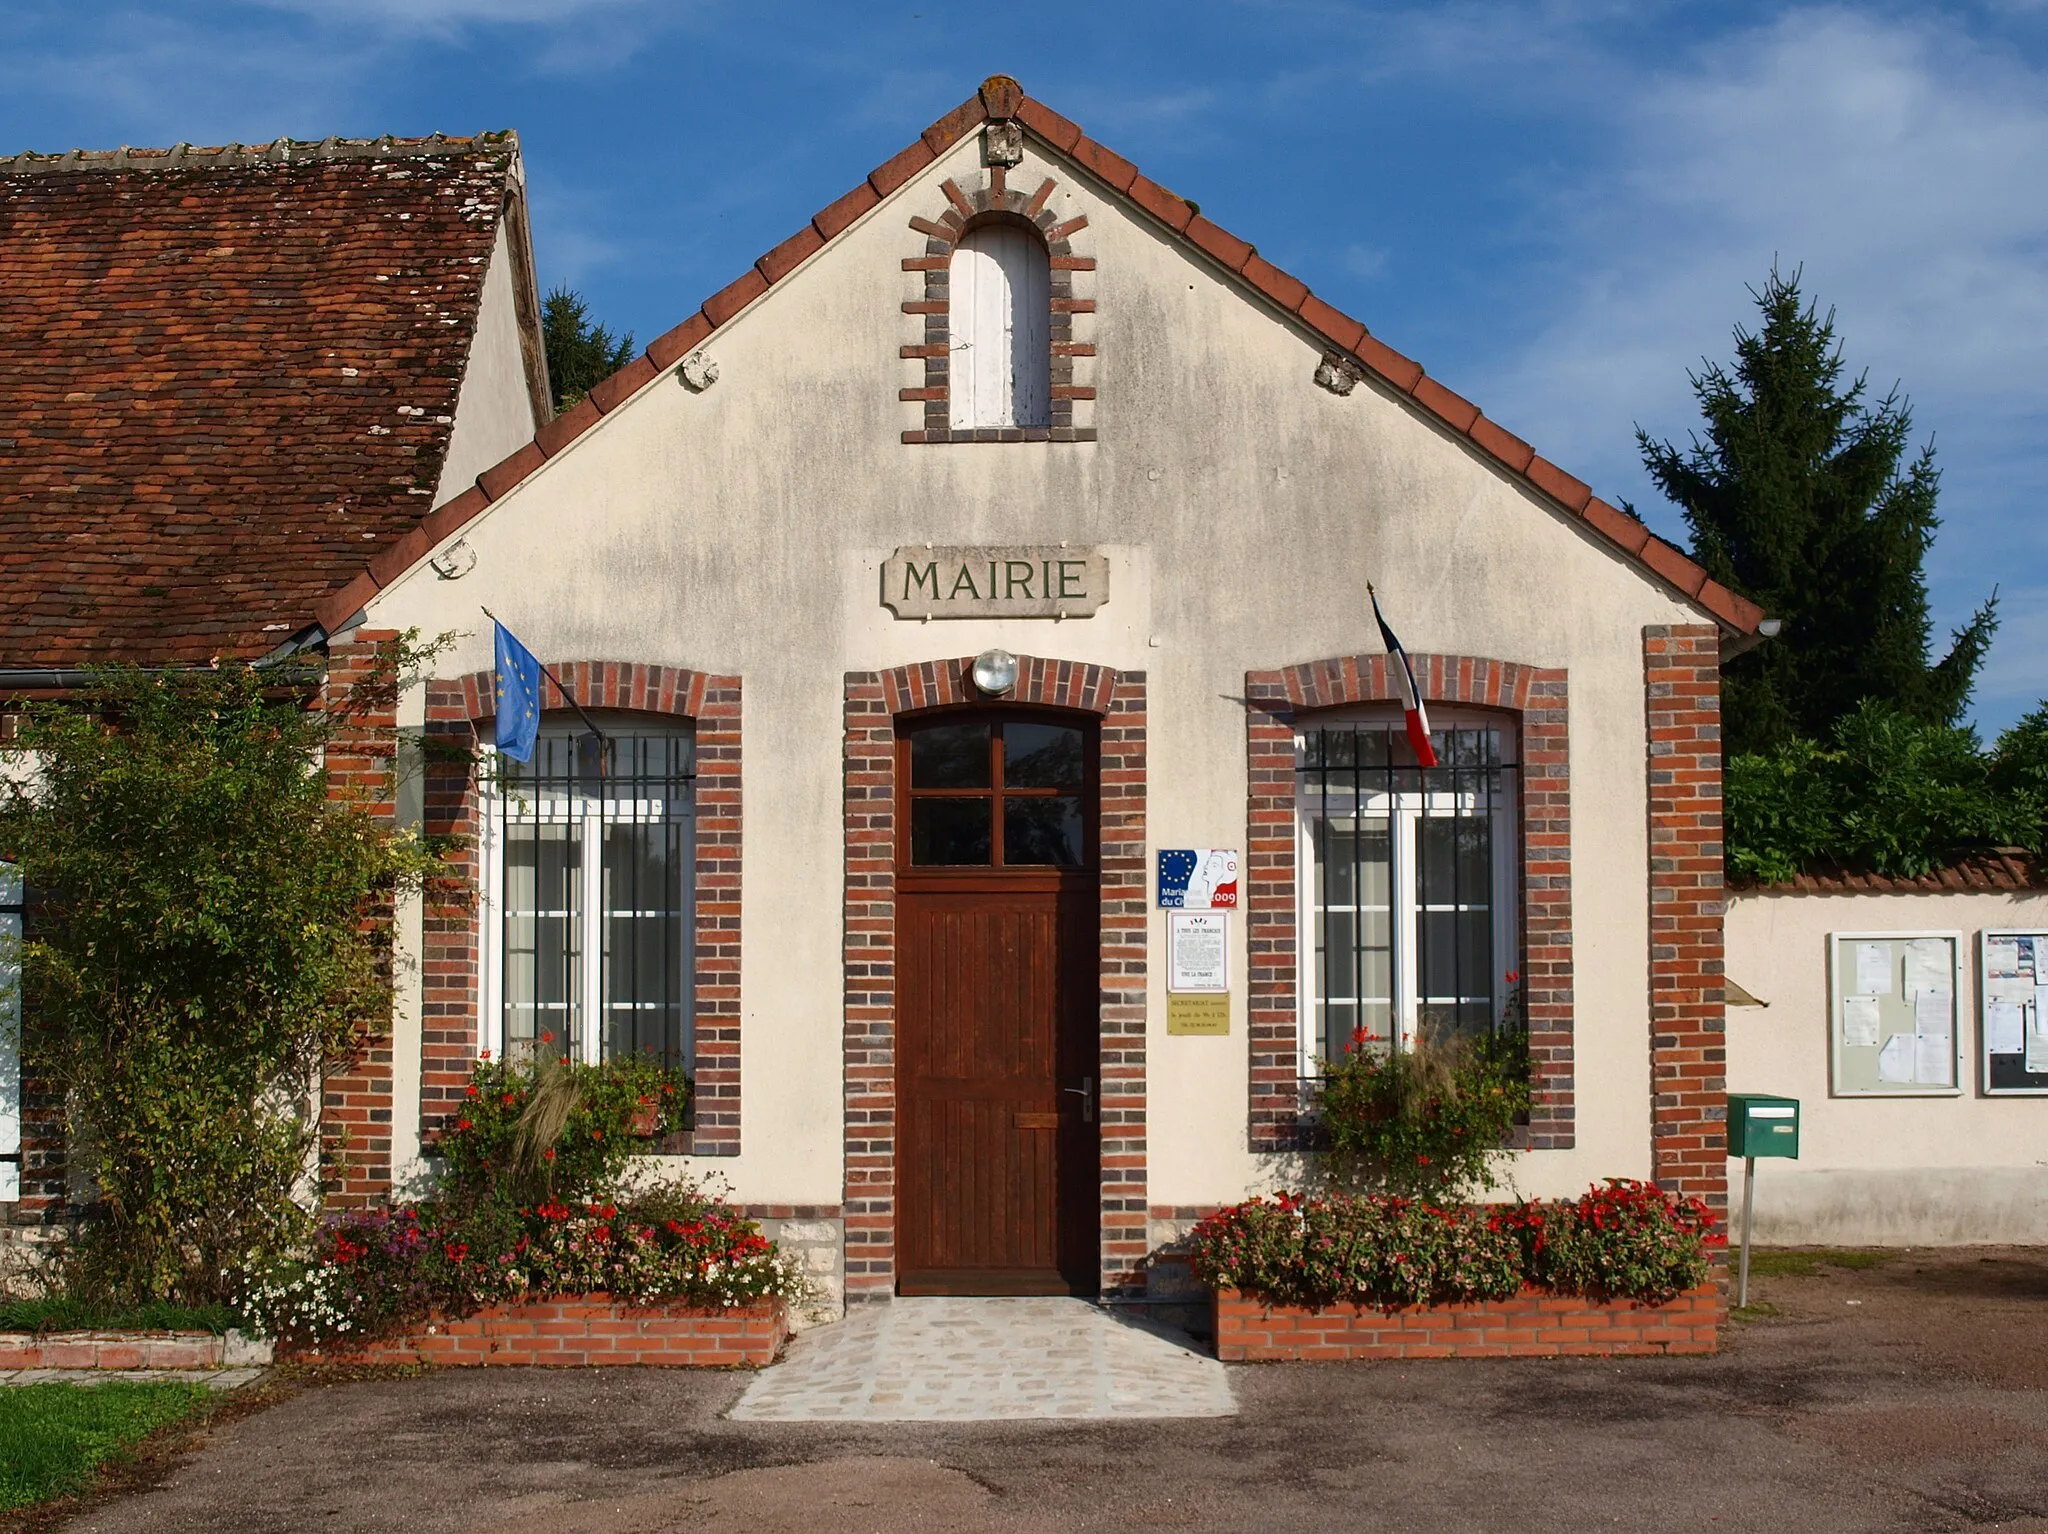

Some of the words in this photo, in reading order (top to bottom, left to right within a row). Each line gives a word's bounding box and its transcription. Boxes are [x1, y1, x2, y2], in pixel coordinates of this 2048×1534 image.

[902, 560, 1087, 601] MAIRIE
[1161, 898, 1173, 906] du
[1211, 893, 1236, 904] 009
